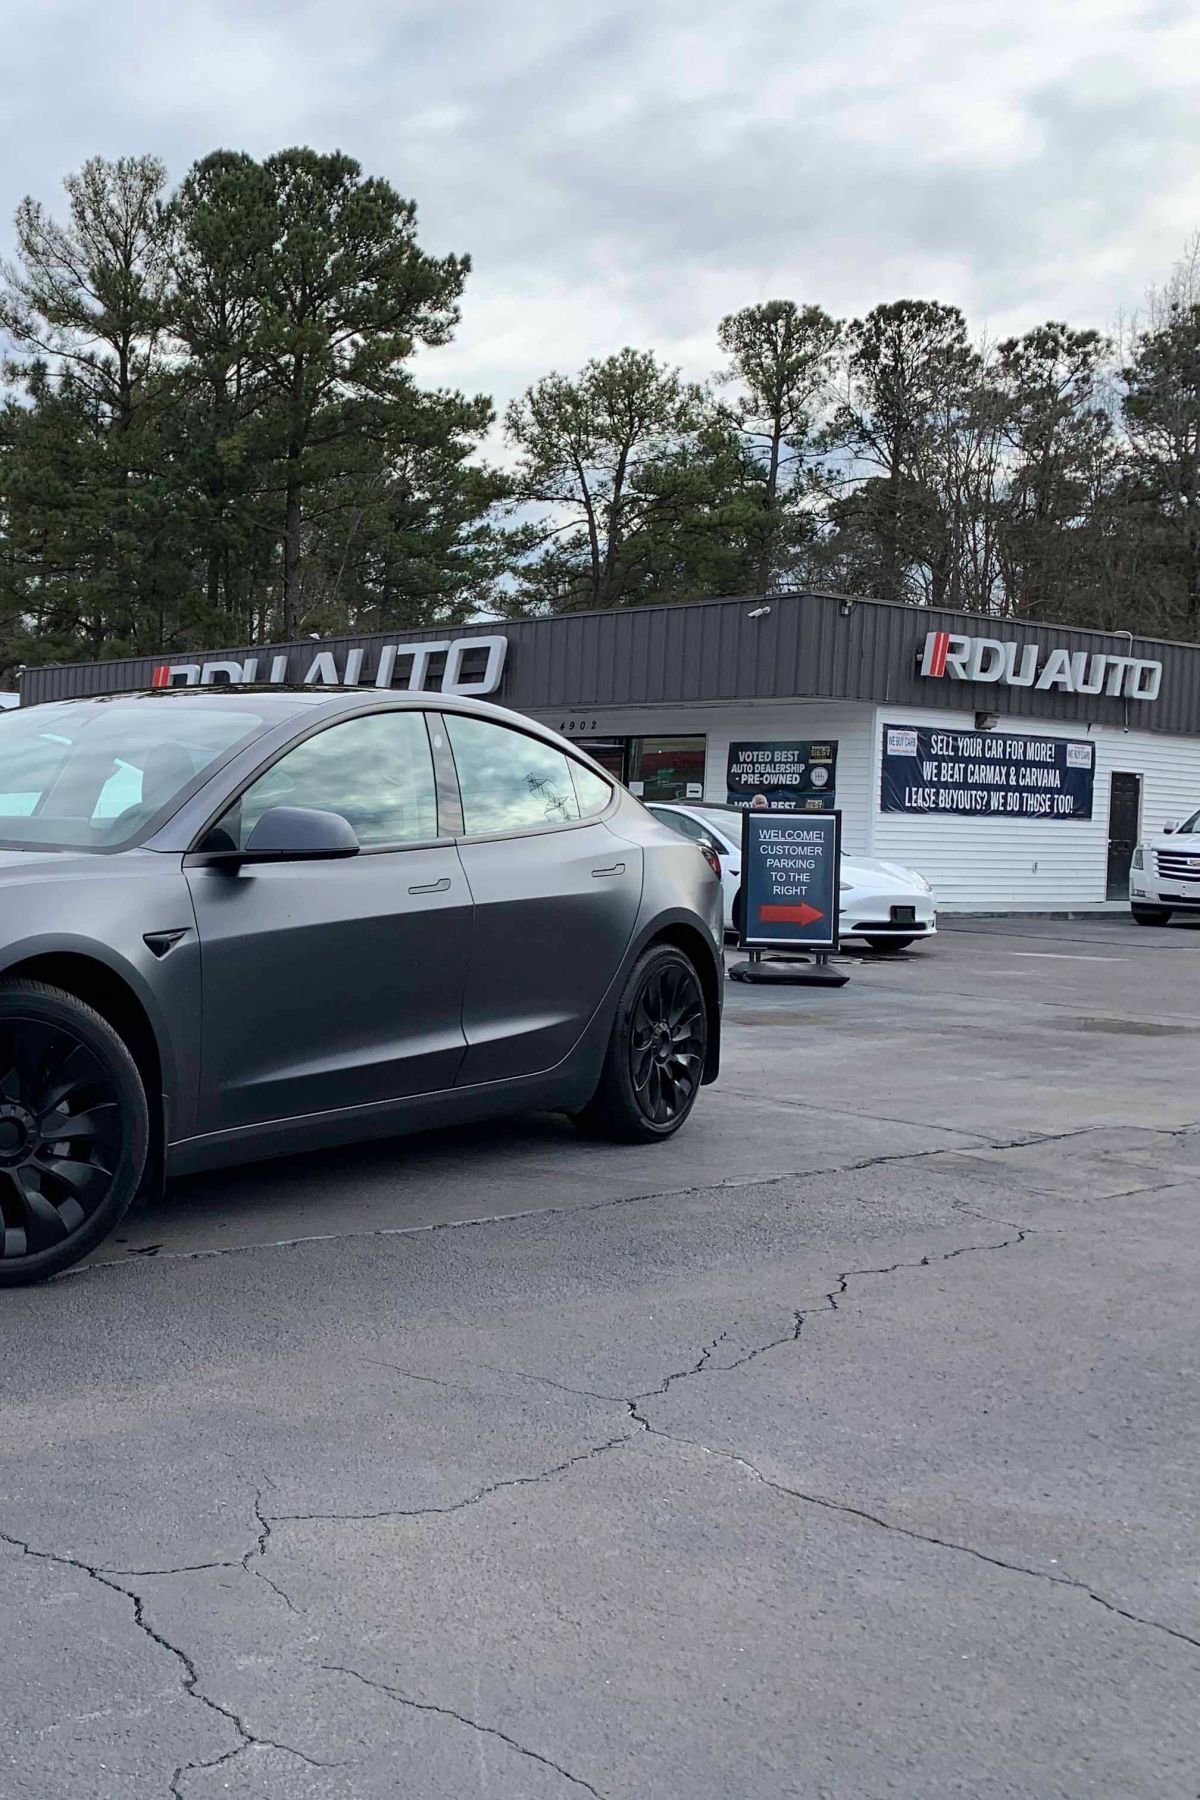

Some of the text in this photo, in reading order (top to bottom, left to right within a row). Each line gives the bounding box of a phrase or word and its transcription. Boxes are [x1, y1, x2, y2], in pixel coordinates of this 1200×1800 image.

[303, 635, 508, 695] AUTO
[559, 721, 597, 731] 4902
[931, 735, 1055, 762] SELL YOUR CAR FOR MORE!
[738, 751, 799, 762] VOTED BEST
[731, 763, 805, 773] AUTO DEALERSHIP
[741, 774, 800, 785] PRE-OWNED
[923, 761, 1060, 788] WE BEAT CARMAX & CARVANA
[905, 787, 1073, 814] LEASE BUYOUTS? WE DO THOSE TOO!
[759, 829, 824, 841] WELCOME!
[760, 845, 823, 856] CUSTOMER
[766, 859, 816, 869] PARKING
[771, 872, 810, 882] TO THE
[773, 886, 807, 896] RIGHT
